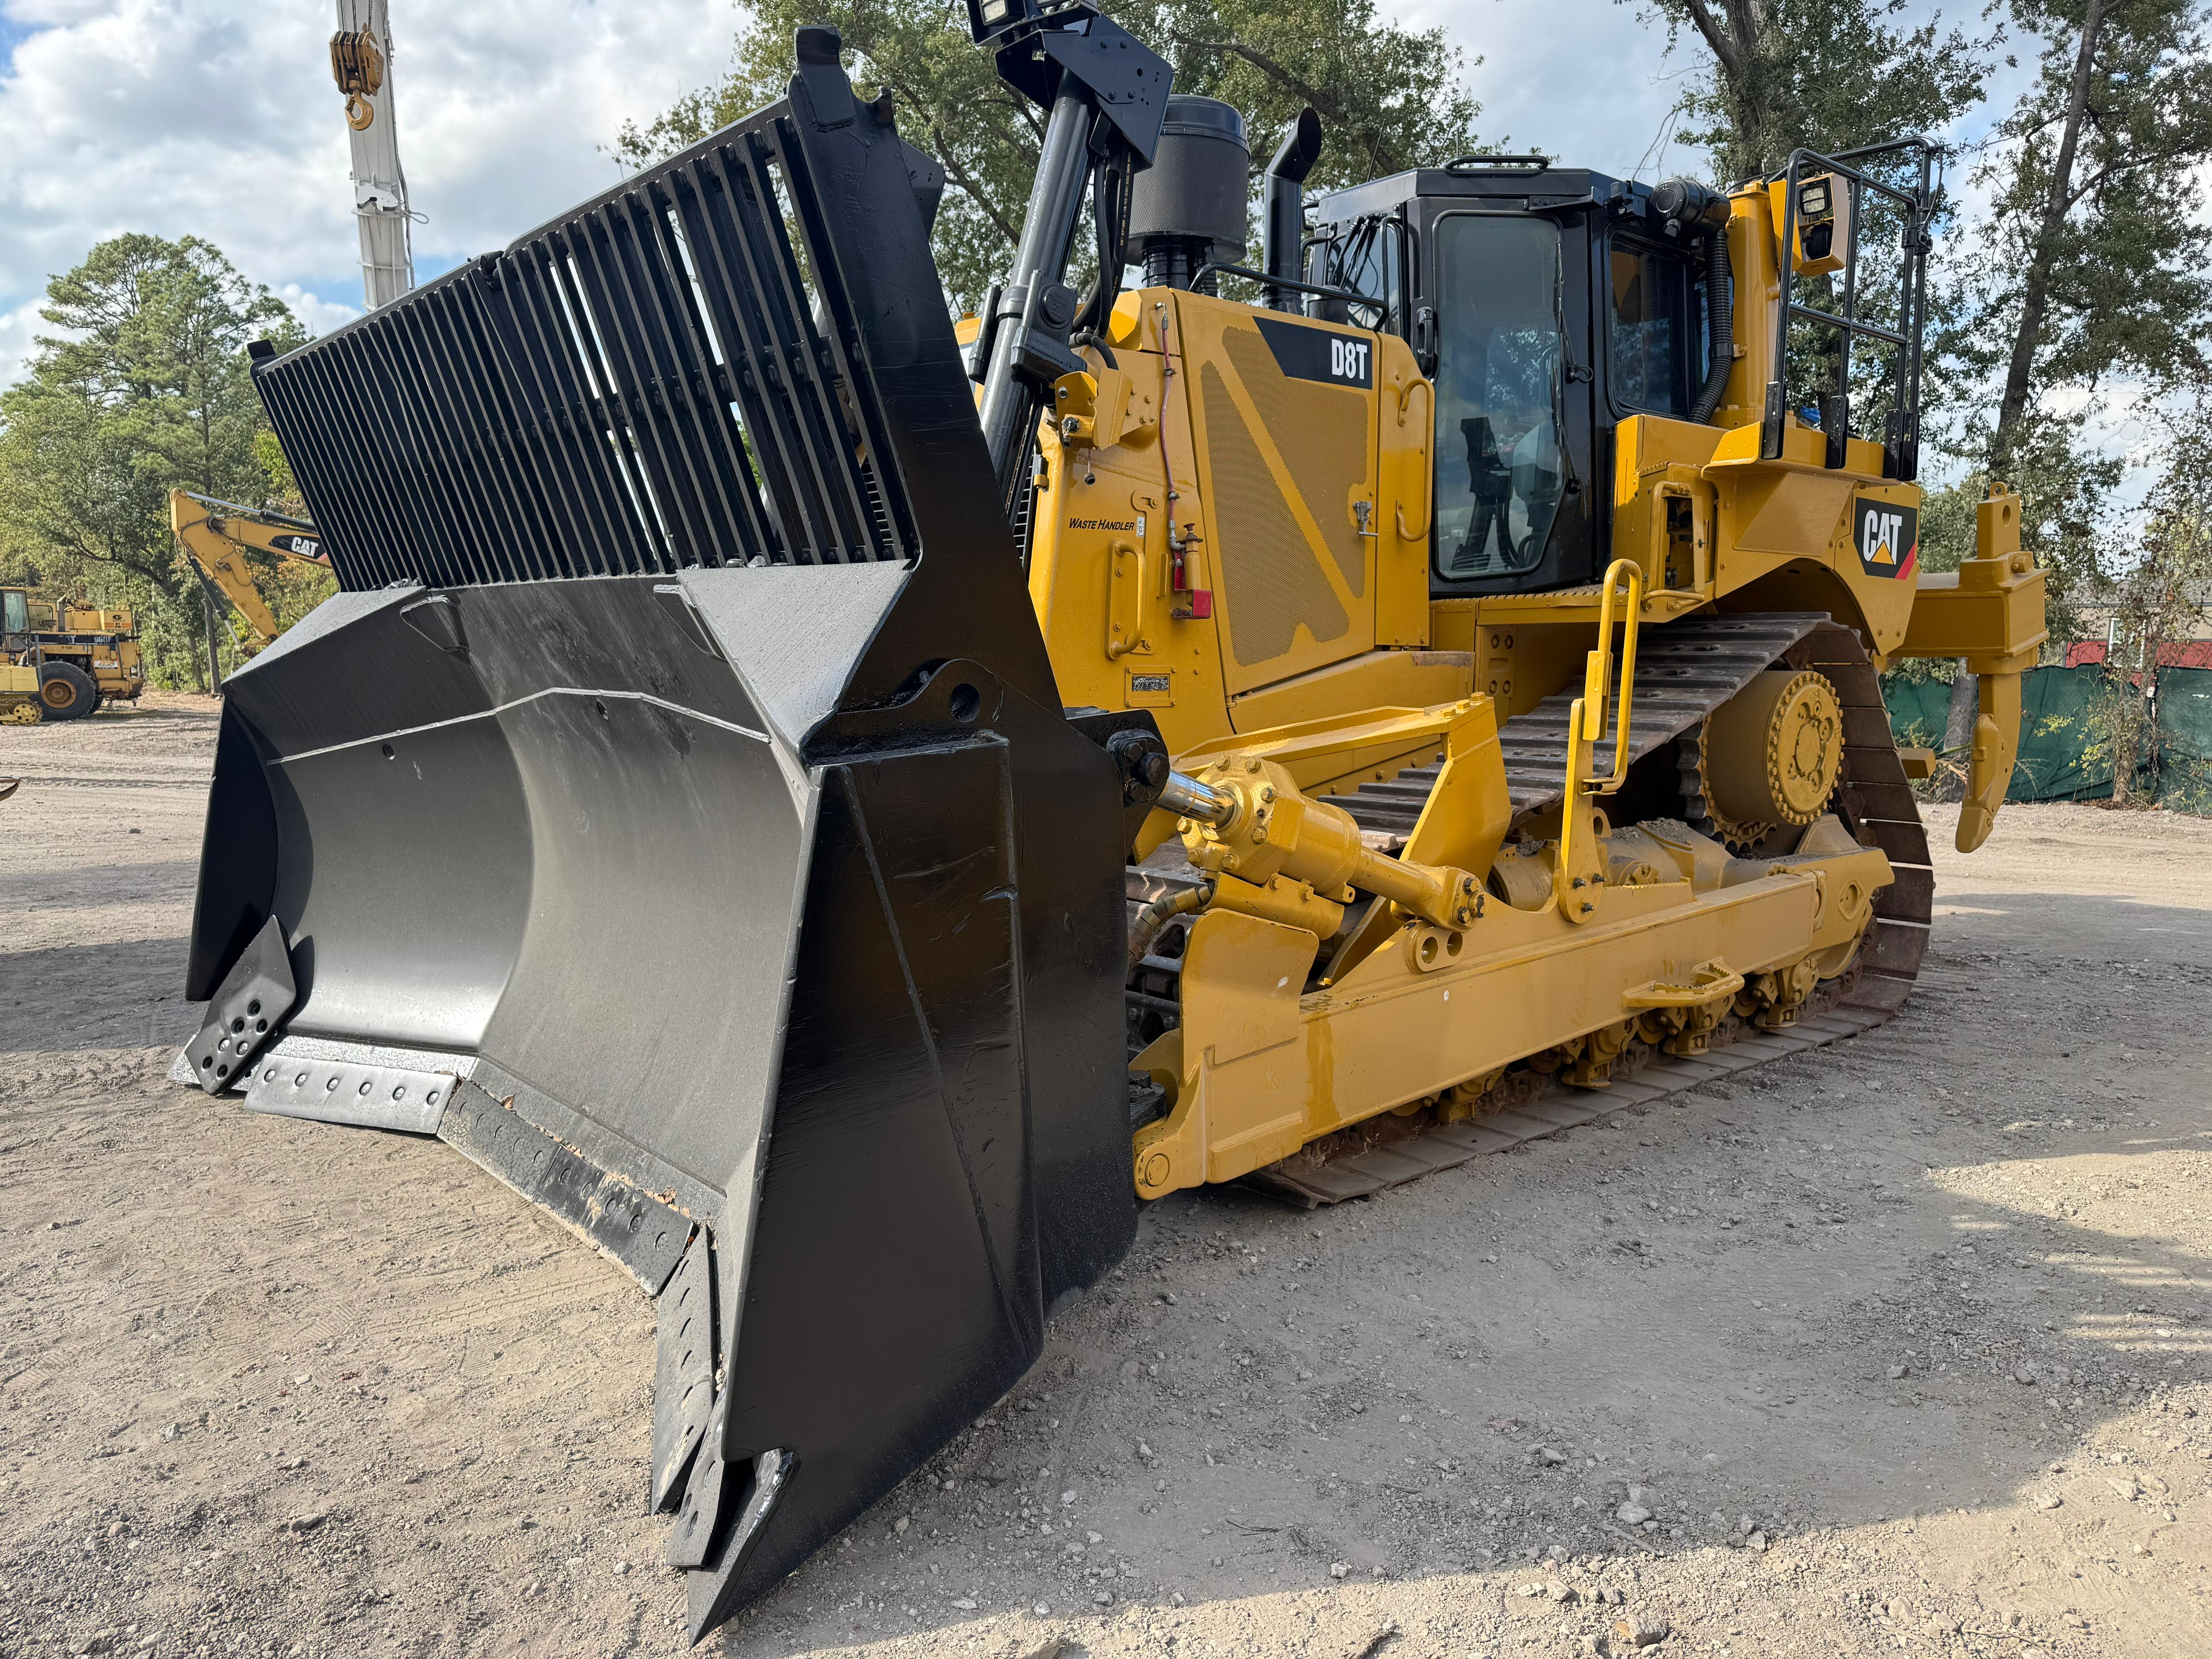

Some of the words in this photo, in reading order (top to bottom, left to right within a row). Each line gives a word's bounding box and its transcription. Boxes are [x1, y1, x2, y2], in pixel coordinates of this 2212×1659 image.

[1332, 338, 1367, 380] D8T
[1069, 518, 1097, 529] WASTE
[1098, 519, 1135, 531] HANDLER
[1863, 510, 1902, 565] CAT
[291, 536, 319, 557] CAT
